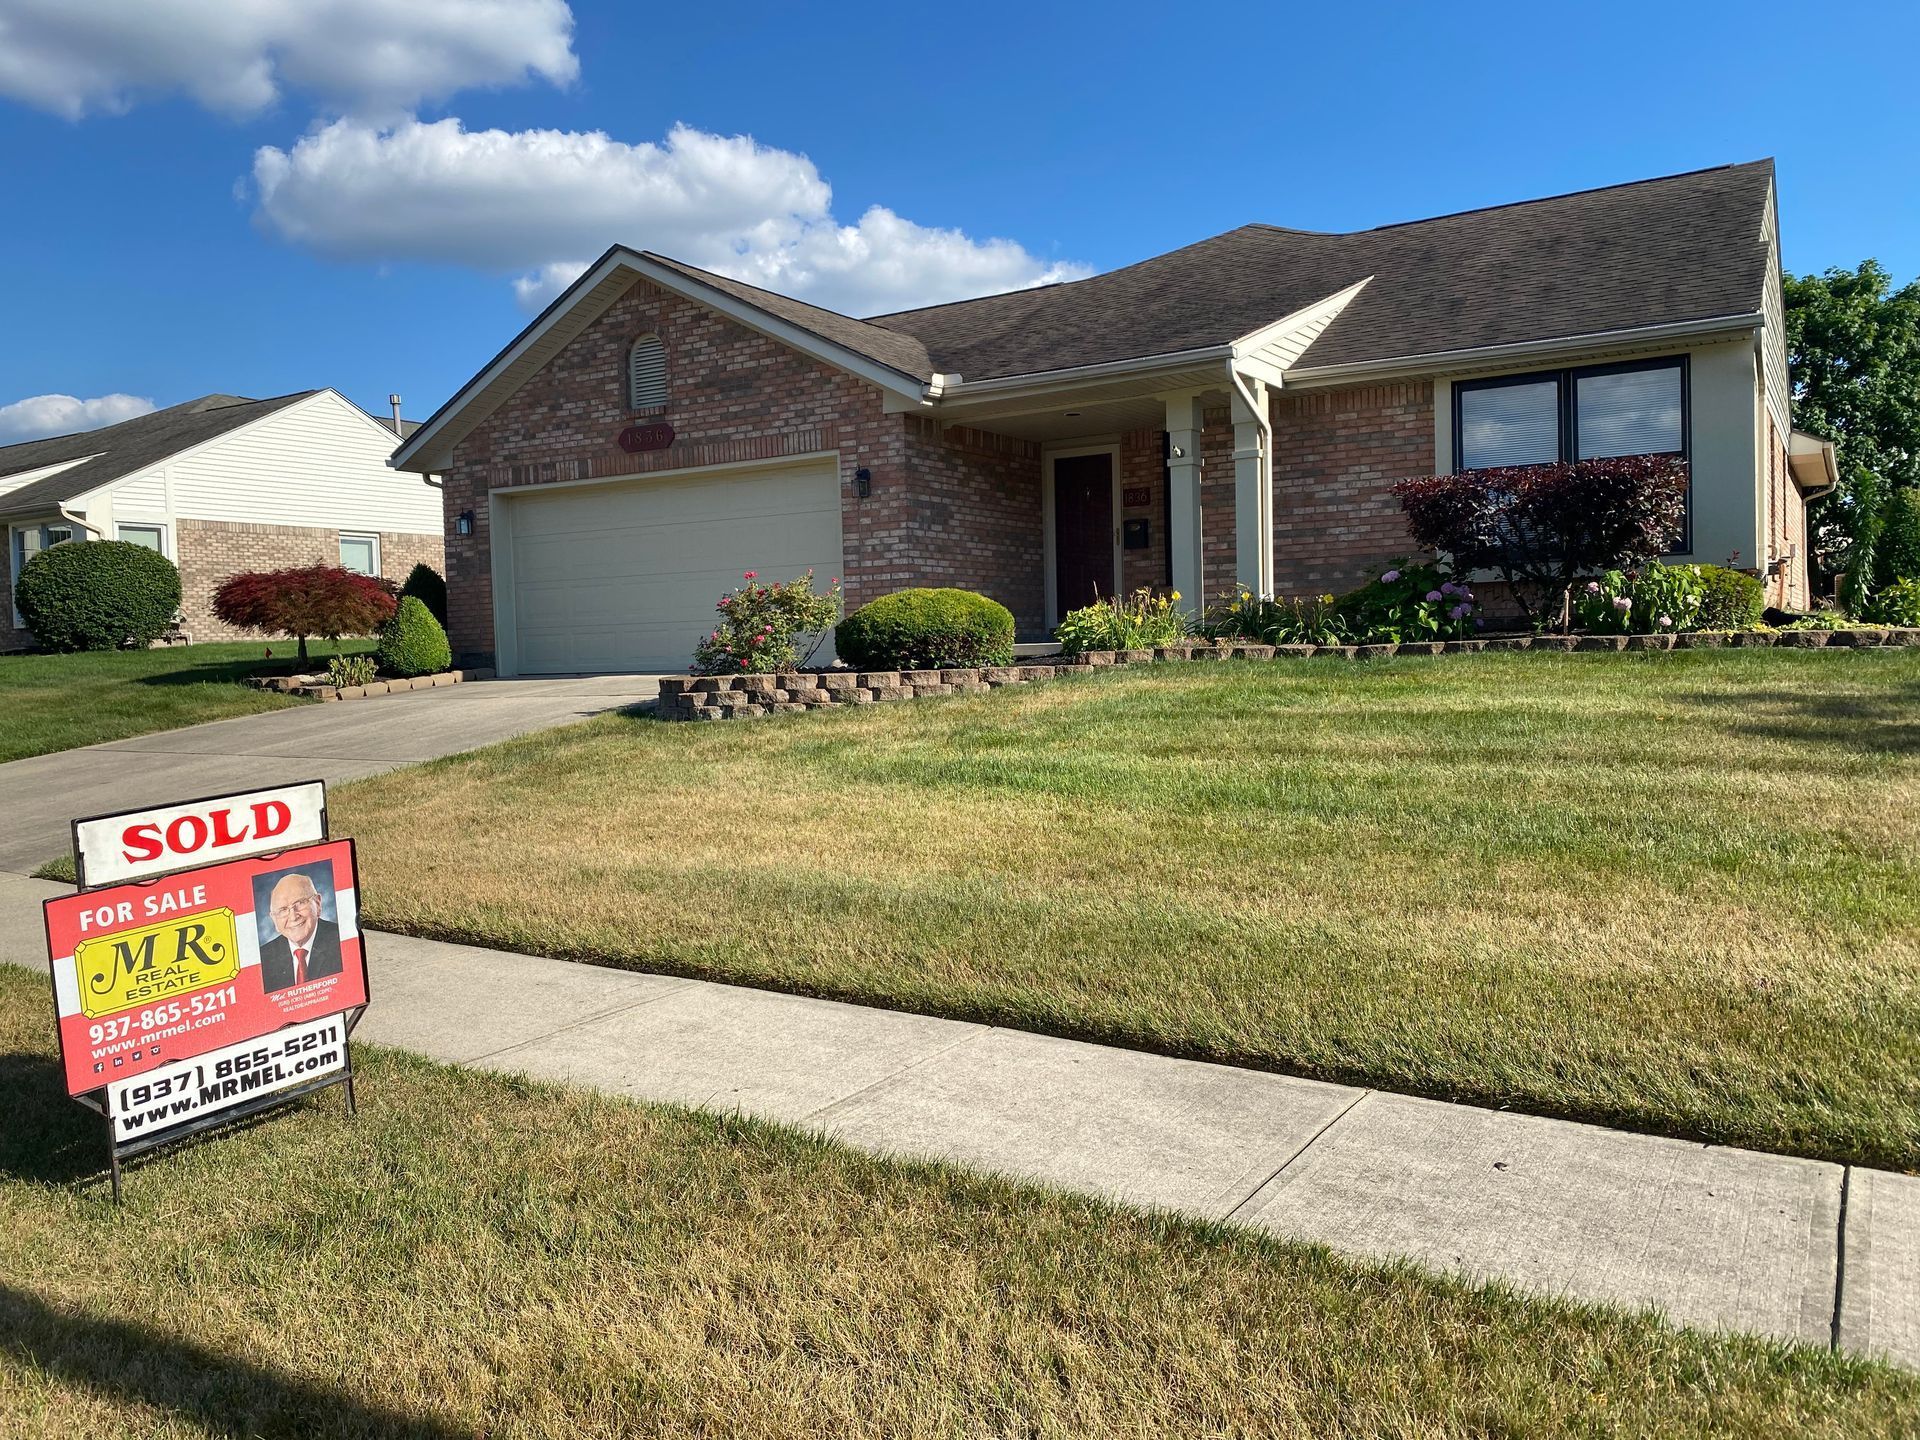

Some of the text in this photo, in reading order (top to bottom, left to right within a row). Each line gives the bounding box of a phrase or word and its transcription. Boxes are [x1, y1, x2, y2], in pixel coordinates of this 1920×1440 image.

[627, 429, 664, 445] 1836
[1125, 492, 1147, 504] 1836
[121, 800, 292, 864] SOLD
[79, 884, 208, 931] FOR SALE
[125, 971, 201, 1001] ESTATE
[135, 964, 190, 984] REAL
[287, 977, 338, 998] RUTHERFORD
[89, 985, 238, 1046] 937-865-5211
[90, 1010, 226, 1059] www.mrmel.com
[120, 1025, 337, 1111] (937) 865-5211
[122, 1047, 338, 1131] www.MRMEL.com
